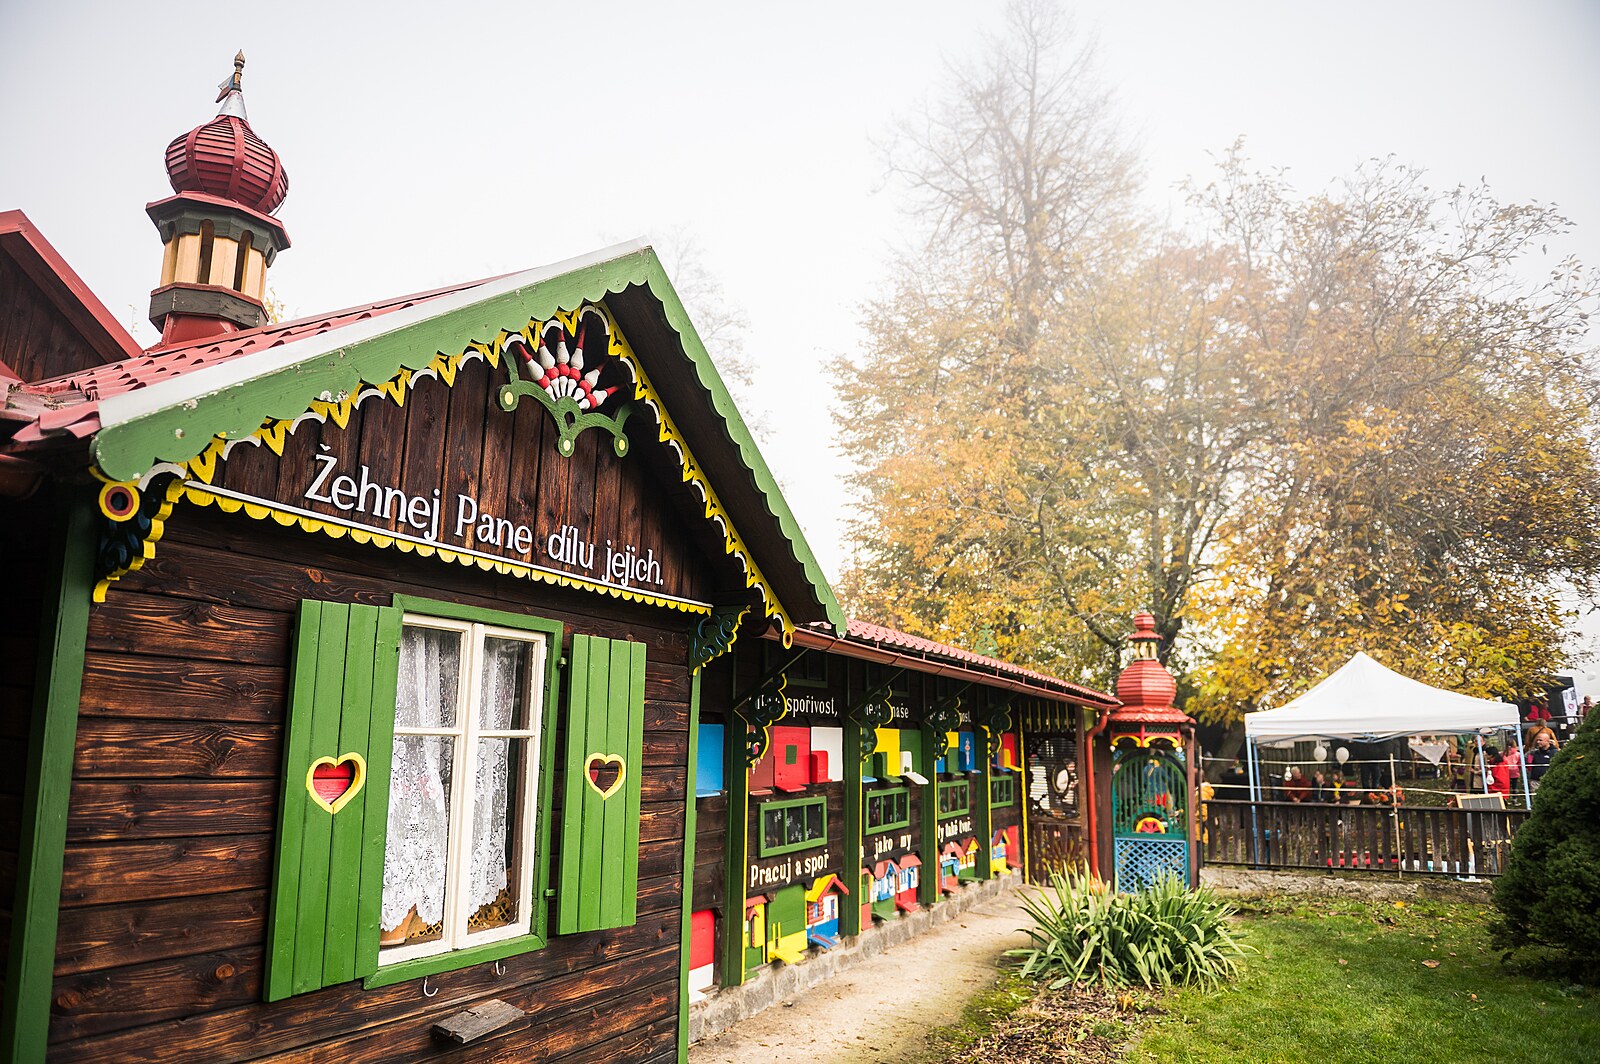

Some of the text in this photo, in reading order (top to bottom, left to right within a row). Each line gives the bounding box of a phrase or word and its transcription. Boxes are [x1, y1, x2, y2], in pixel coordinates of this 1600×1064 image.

[304, 443, 664, 587] Žehnej Pane dílu jejich.
[873, 835, 893, 861] jako
[900, 834, 912, 851] my
[750, 848, 830, 888] Pracuj a spoř
